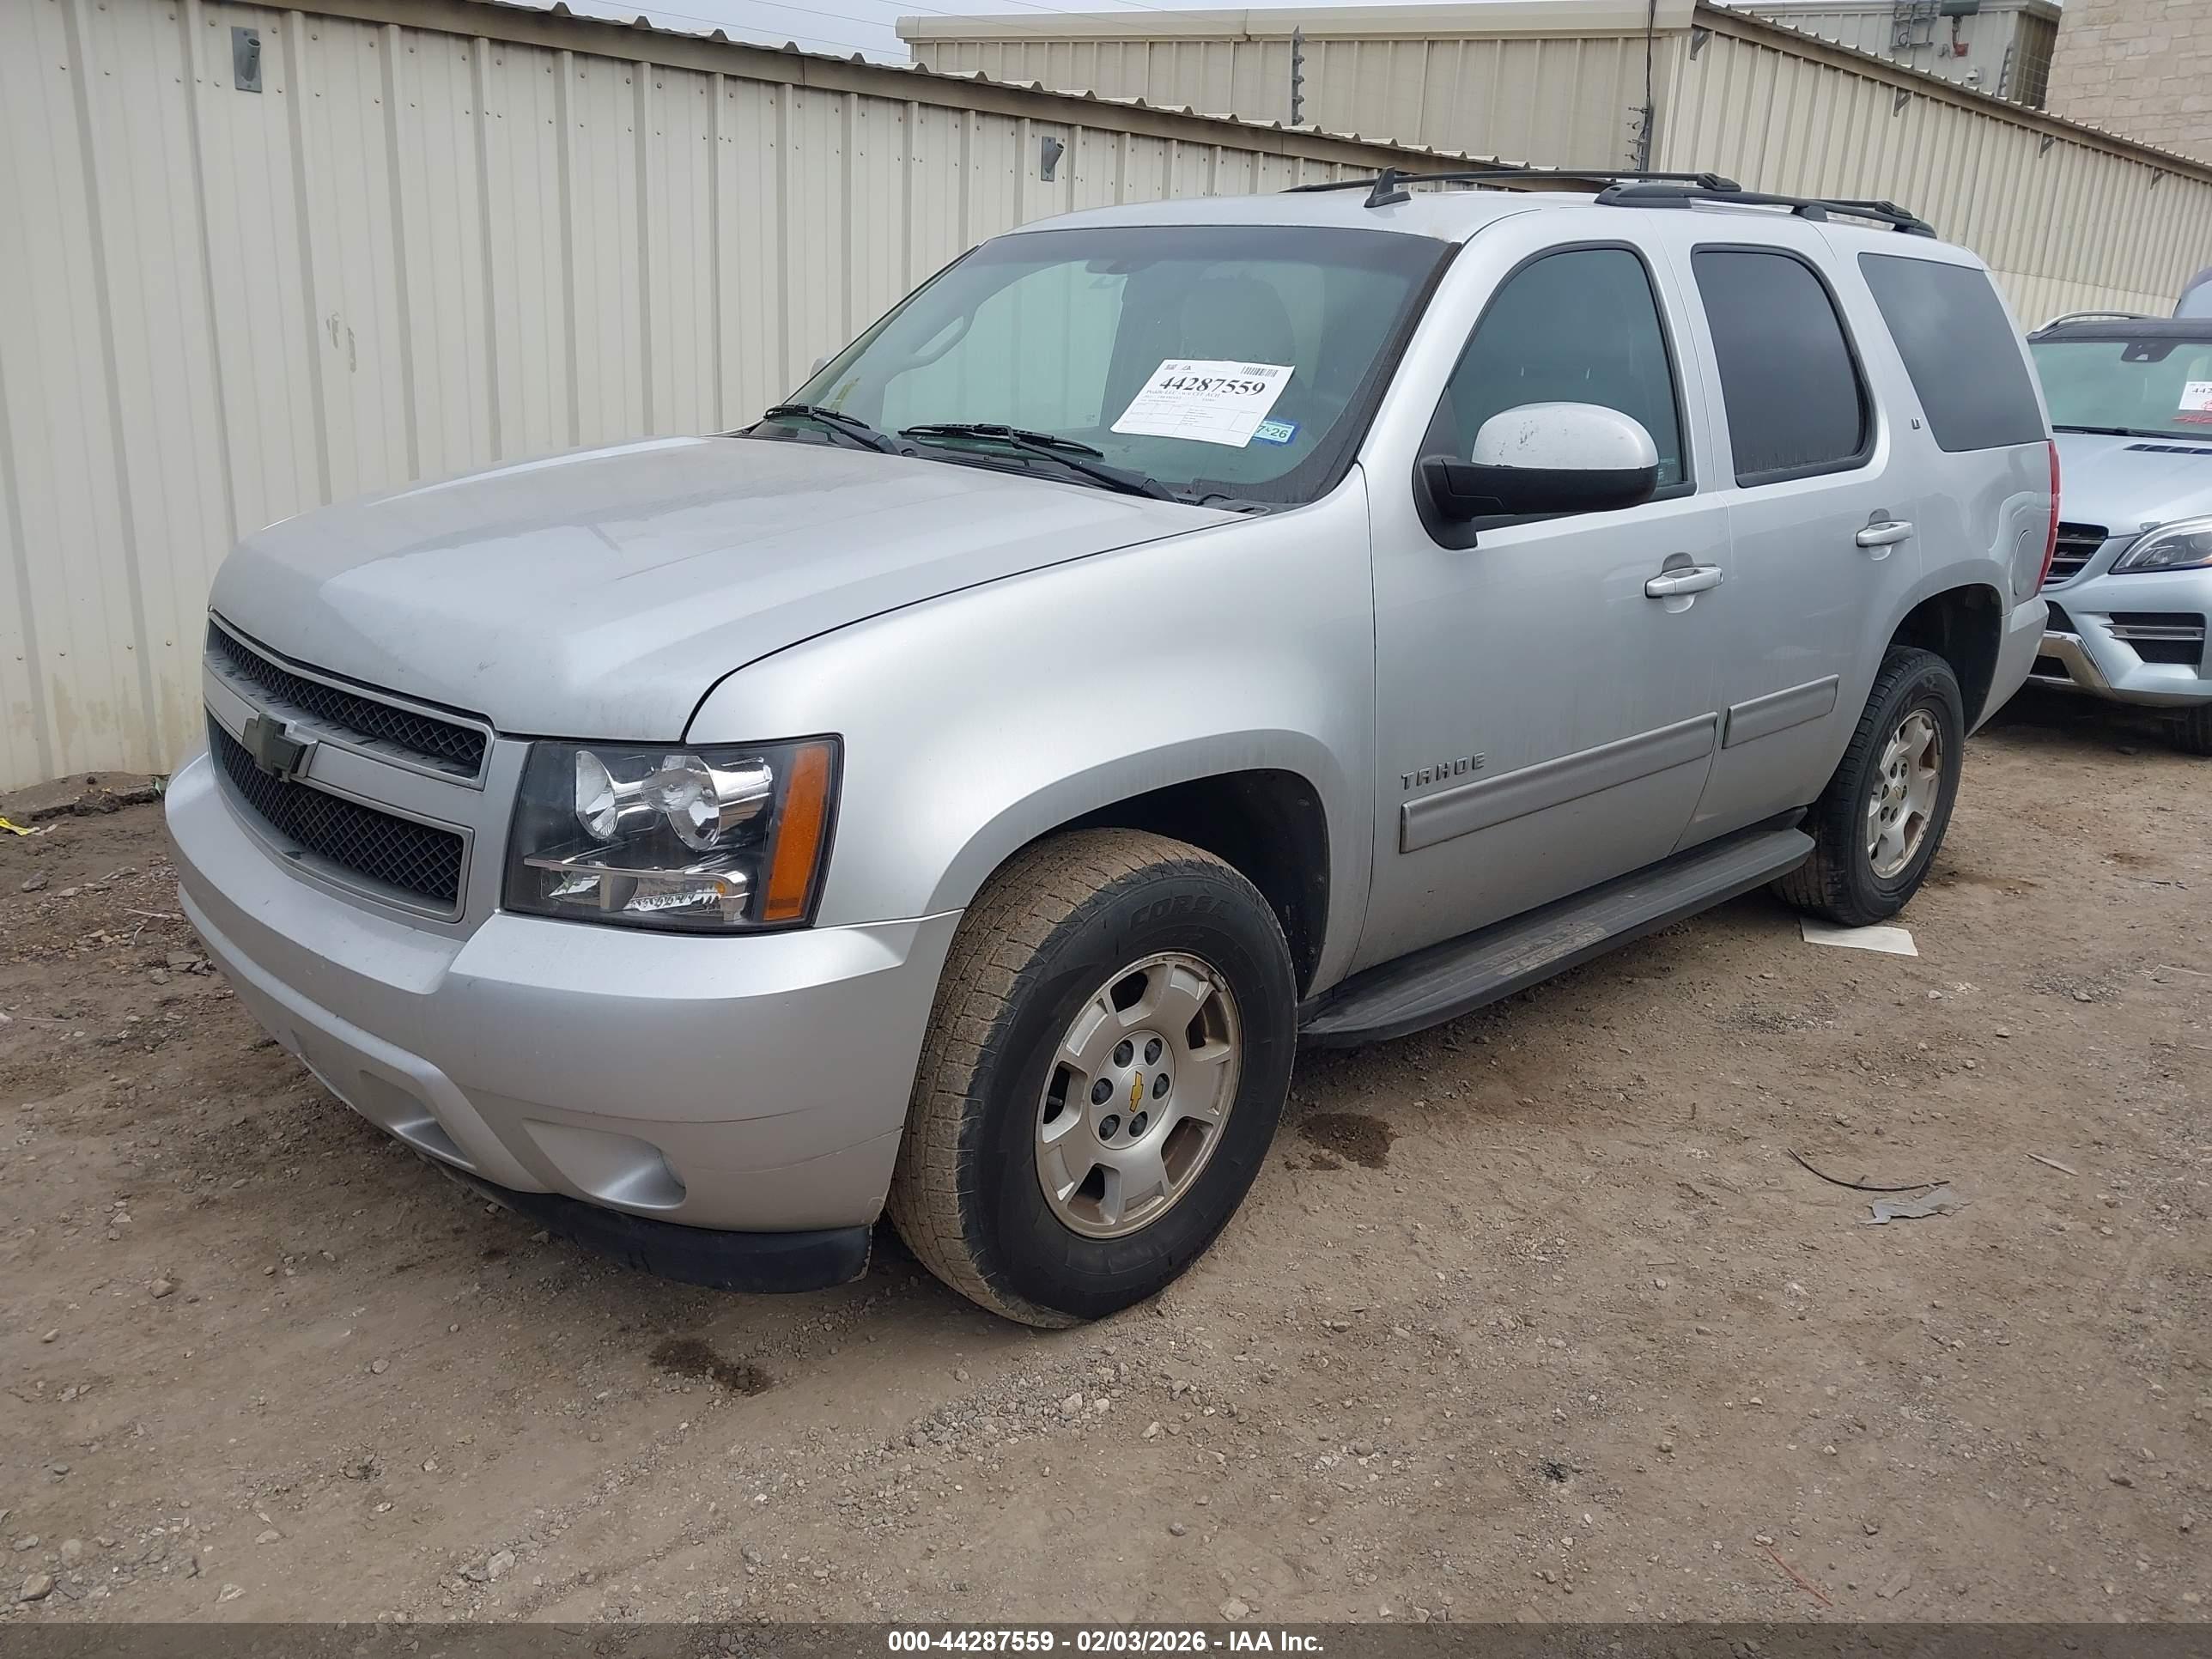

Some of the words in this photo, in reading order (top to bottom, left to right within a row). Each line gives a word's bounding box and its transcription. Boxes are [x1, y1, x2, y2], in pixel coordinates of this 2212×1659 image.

[1159, 376, 1266, 396] 44287559
[1270, 428, 1289, 439] 26
[1401, 751, 1485, 790] TAHOE
[1129, 894, 1231, 931] CORSA
